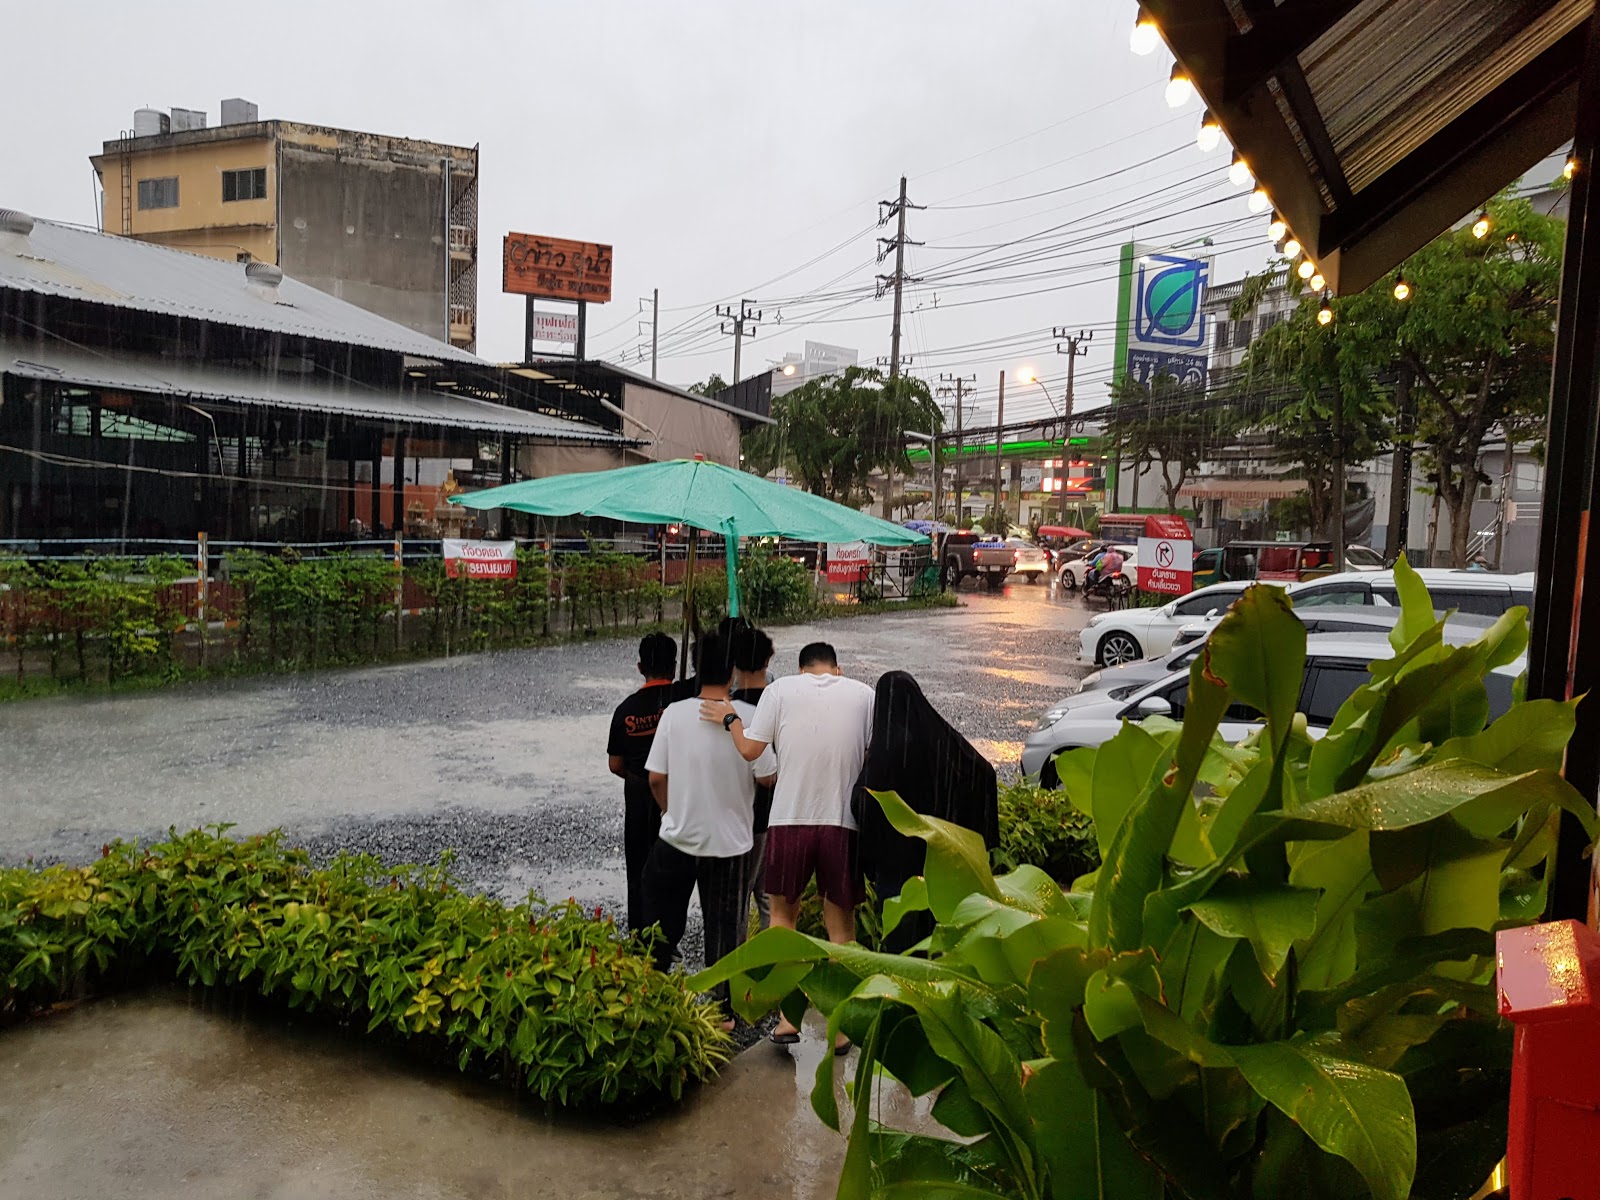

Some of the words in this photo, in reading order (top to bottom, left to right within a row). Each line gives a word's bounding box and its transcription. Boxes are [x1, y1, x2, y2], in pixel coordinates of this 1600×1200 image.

[461, 542, 503, 557] ที่จอดรถ
[1152, 569, 1177, 580] อันตราย
[1147, 579, 1181, 592] ห้ามเลี้ยวขวา
